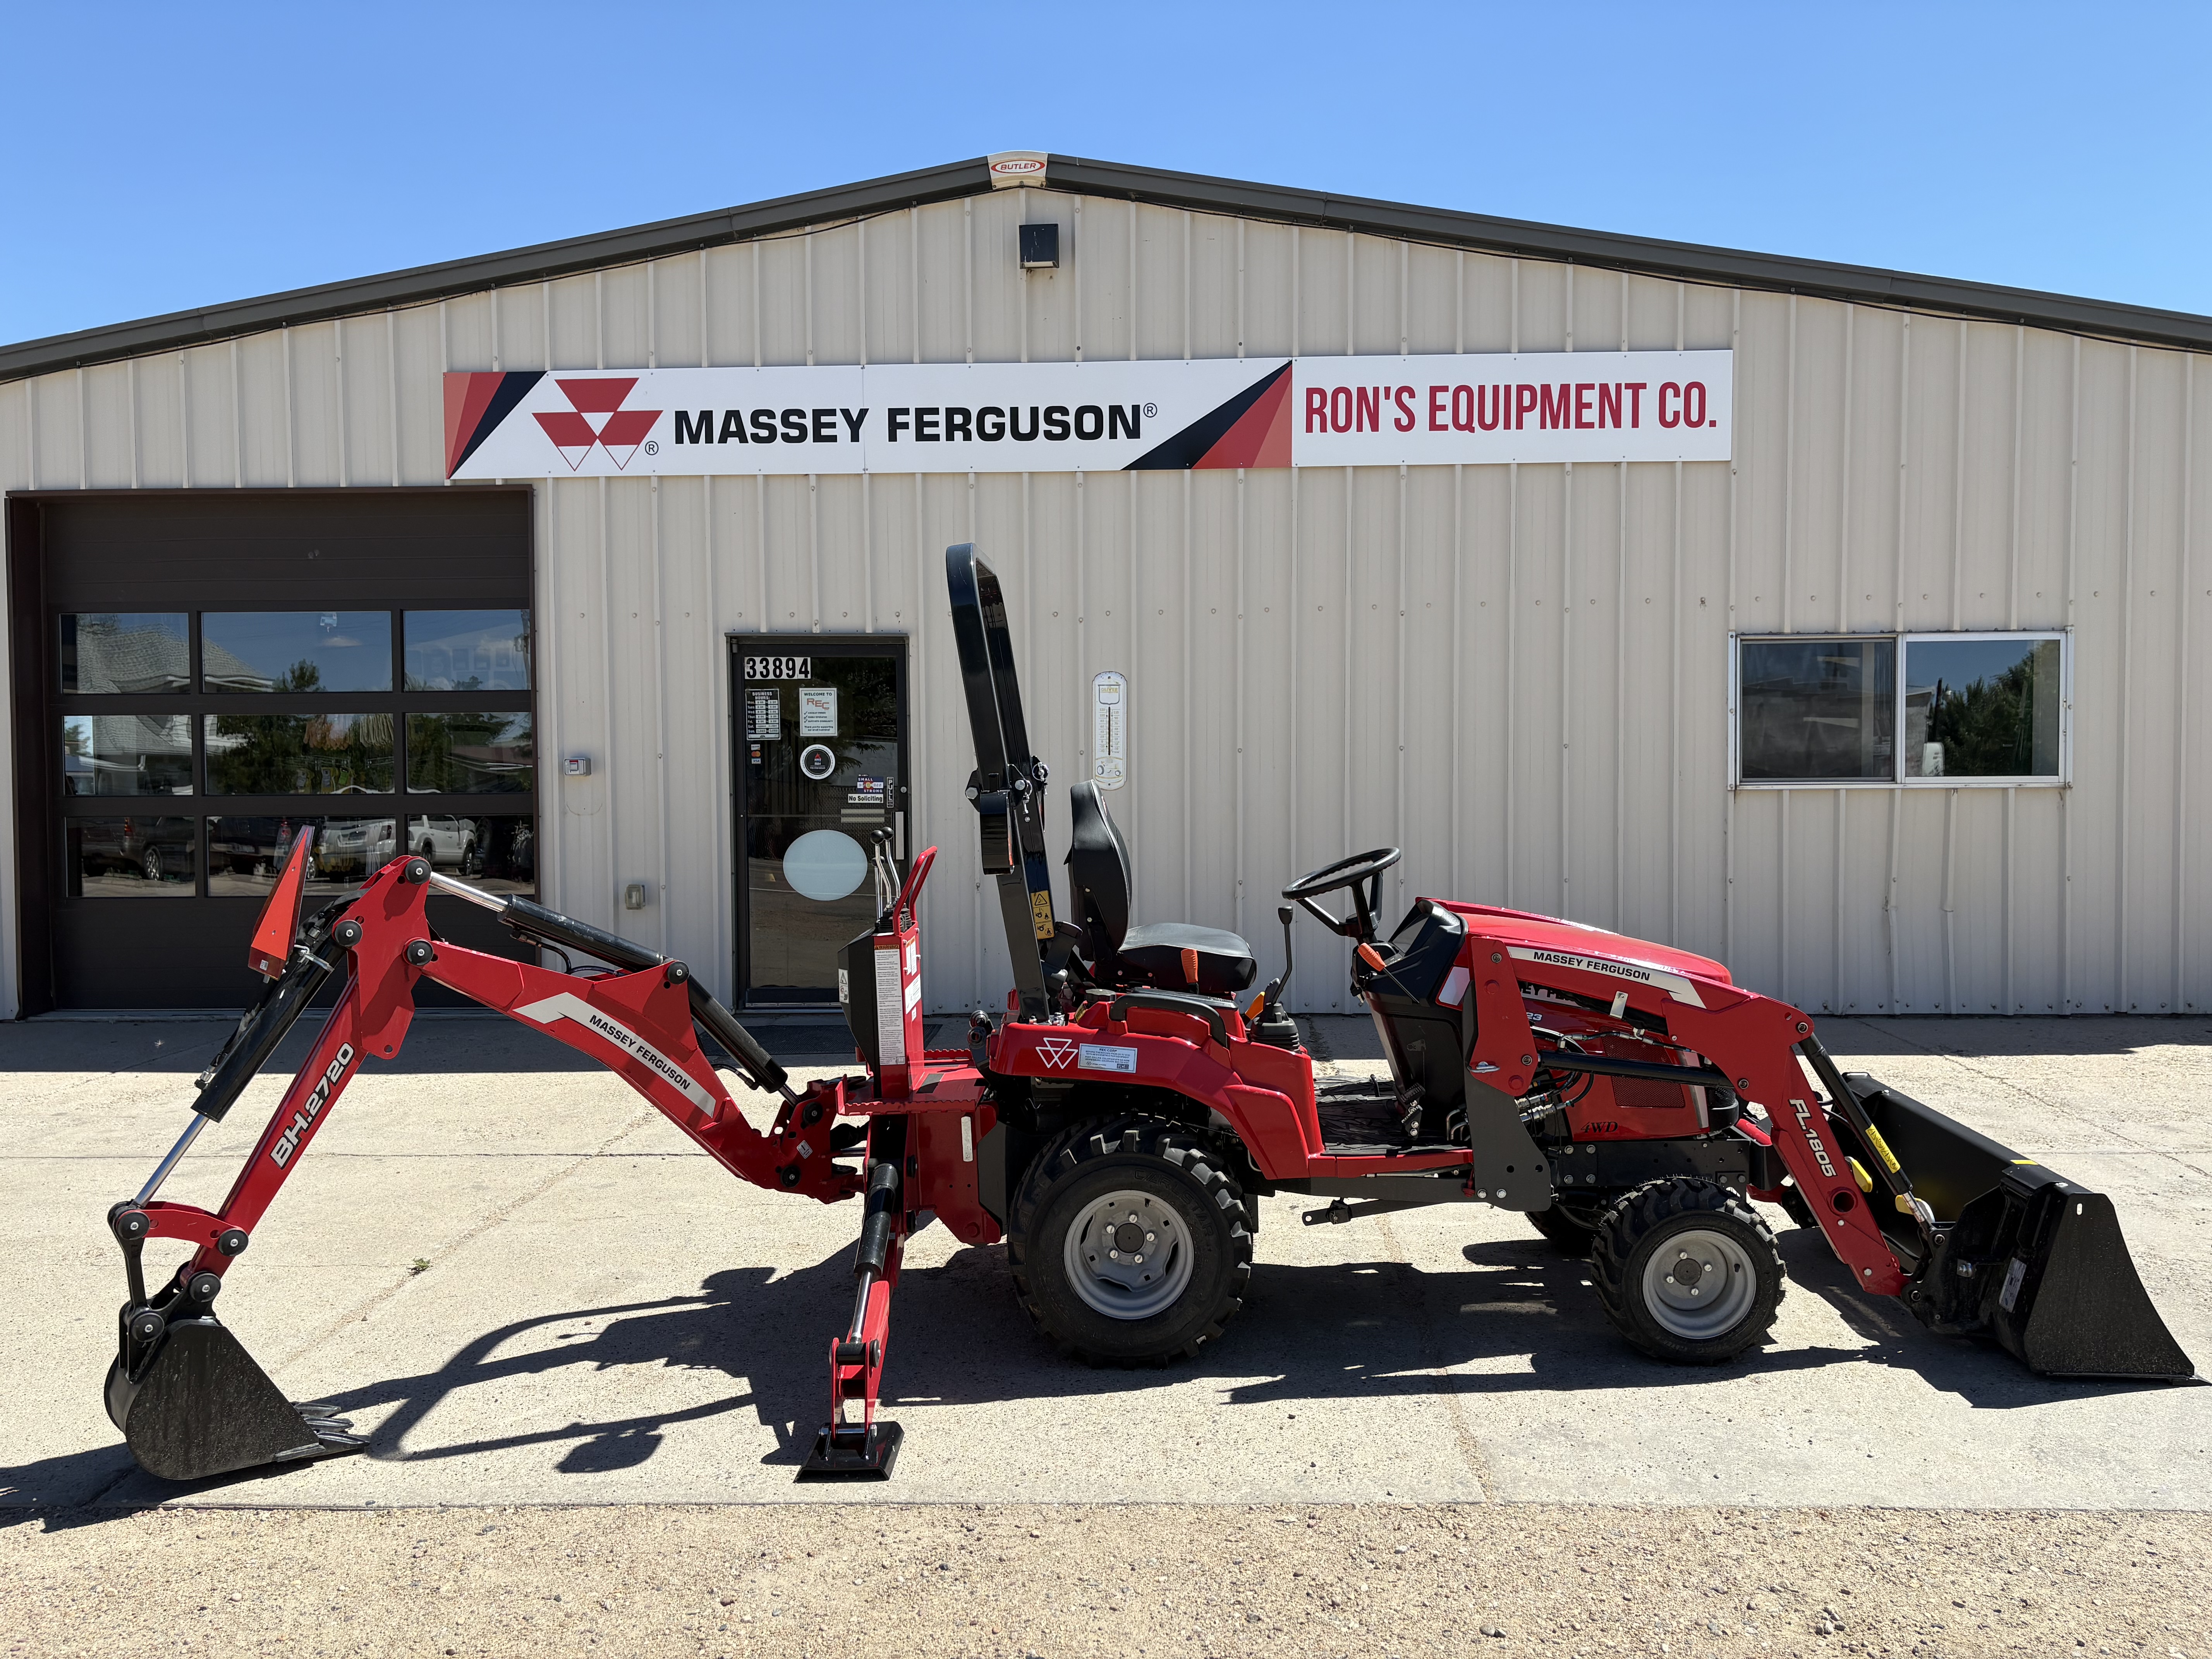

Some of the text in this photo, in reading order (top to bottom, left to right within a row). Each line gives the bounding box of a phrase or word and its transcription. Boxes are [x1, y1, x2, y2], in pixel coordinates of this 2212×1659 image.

[674, 408, 869, 444] MASSEY
[1305, 381, 1717, 433] RON'S EQUIPMENT CO.
[746, 658, 809, 678] 33894
[807, 698, 830, 709] REC
[1533, 951, 1650, 982] MASSEY FERGUSON
[589, 1014, 691, 1091] MASSEY FERGUSON
[270, 1042, 354, 1169] BH.2720
[1580, 1121, 1618, 1133] 4WD
[1788, 1098, 1838, 1178] FL.1805
[1133, 1168, 1214, 1236] CARLSTAR
